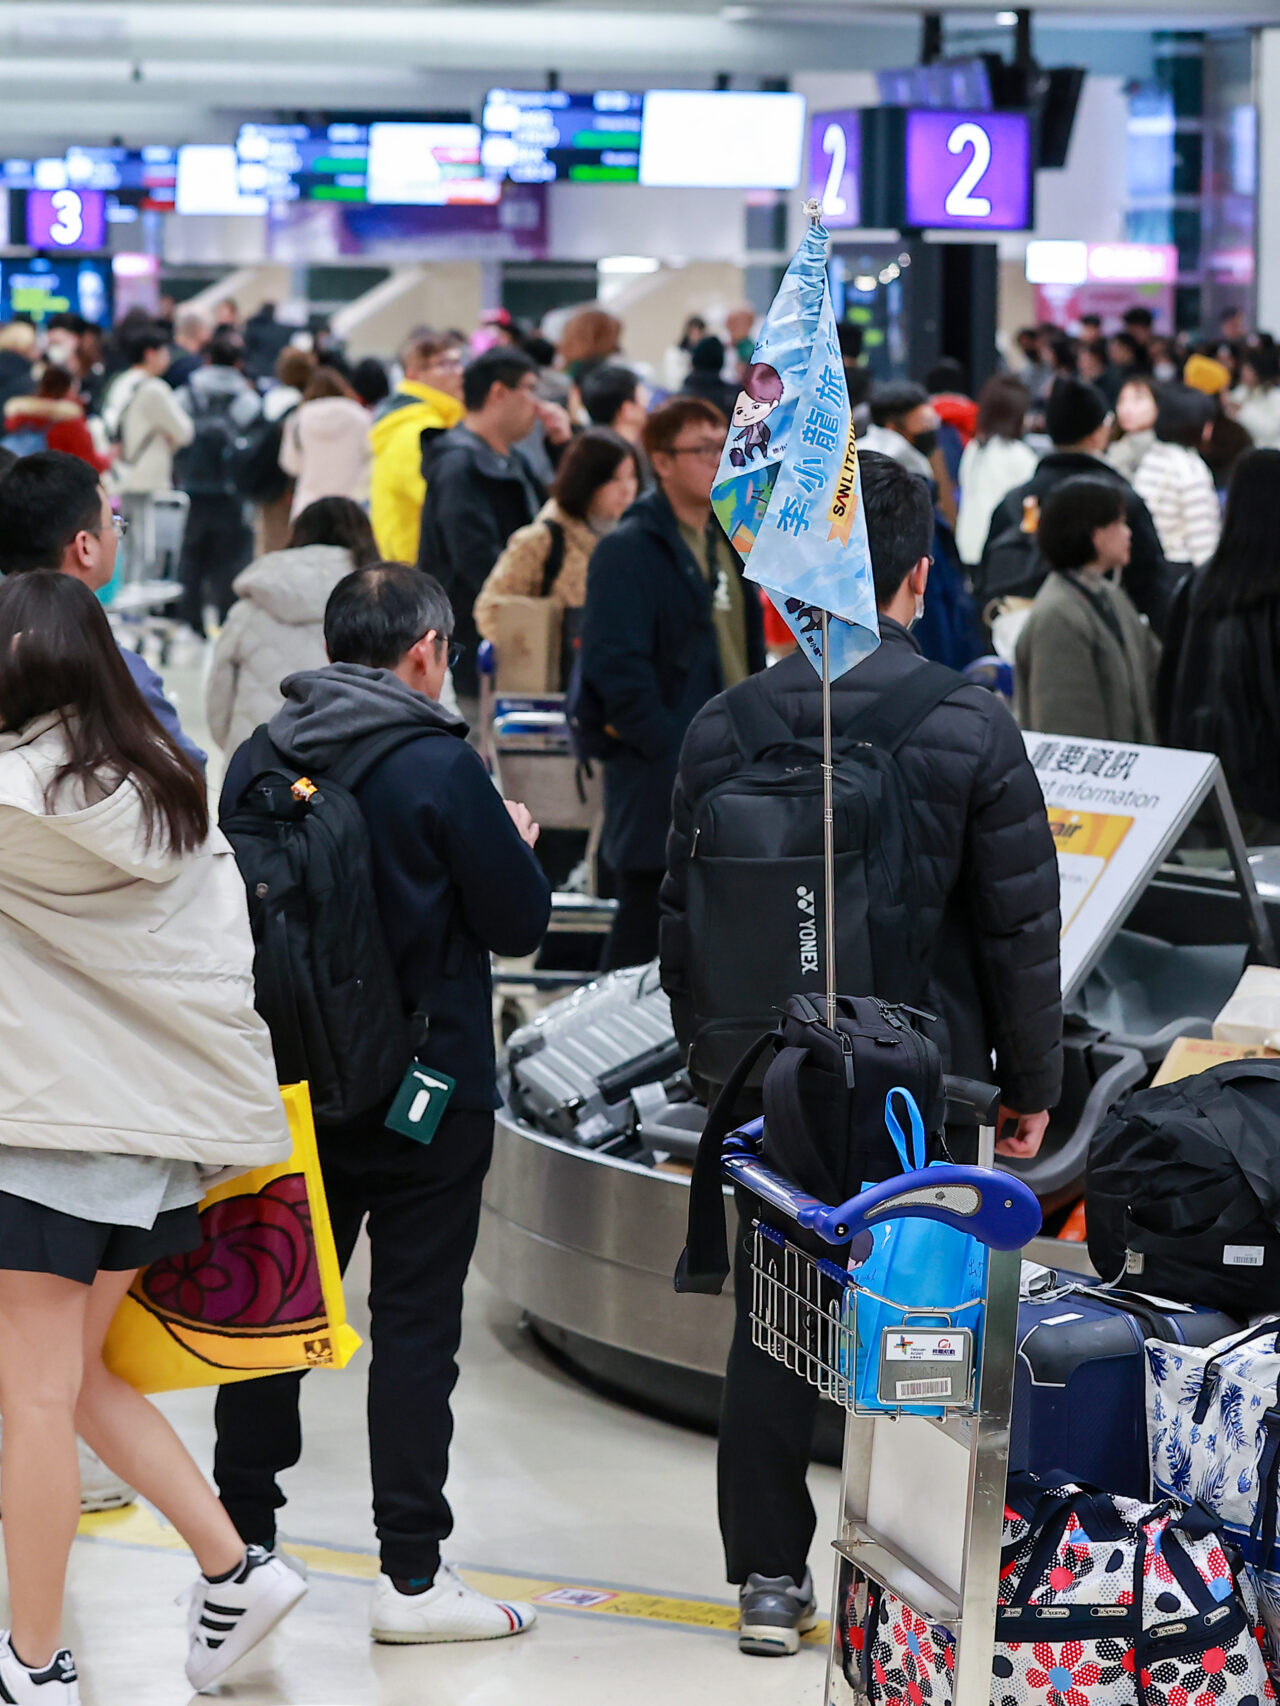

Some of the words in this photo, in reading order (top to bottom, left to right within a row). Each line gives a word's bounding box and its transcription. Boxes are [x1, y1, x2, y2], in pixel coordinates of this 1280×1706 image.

[822, 122, 847, 217] 2
[945, 122, 992, 217] 2
[49, 189, 83, 245] 3
[1057, 779, 1160, 809] information
[799, 918, 819, 976] YONEX
